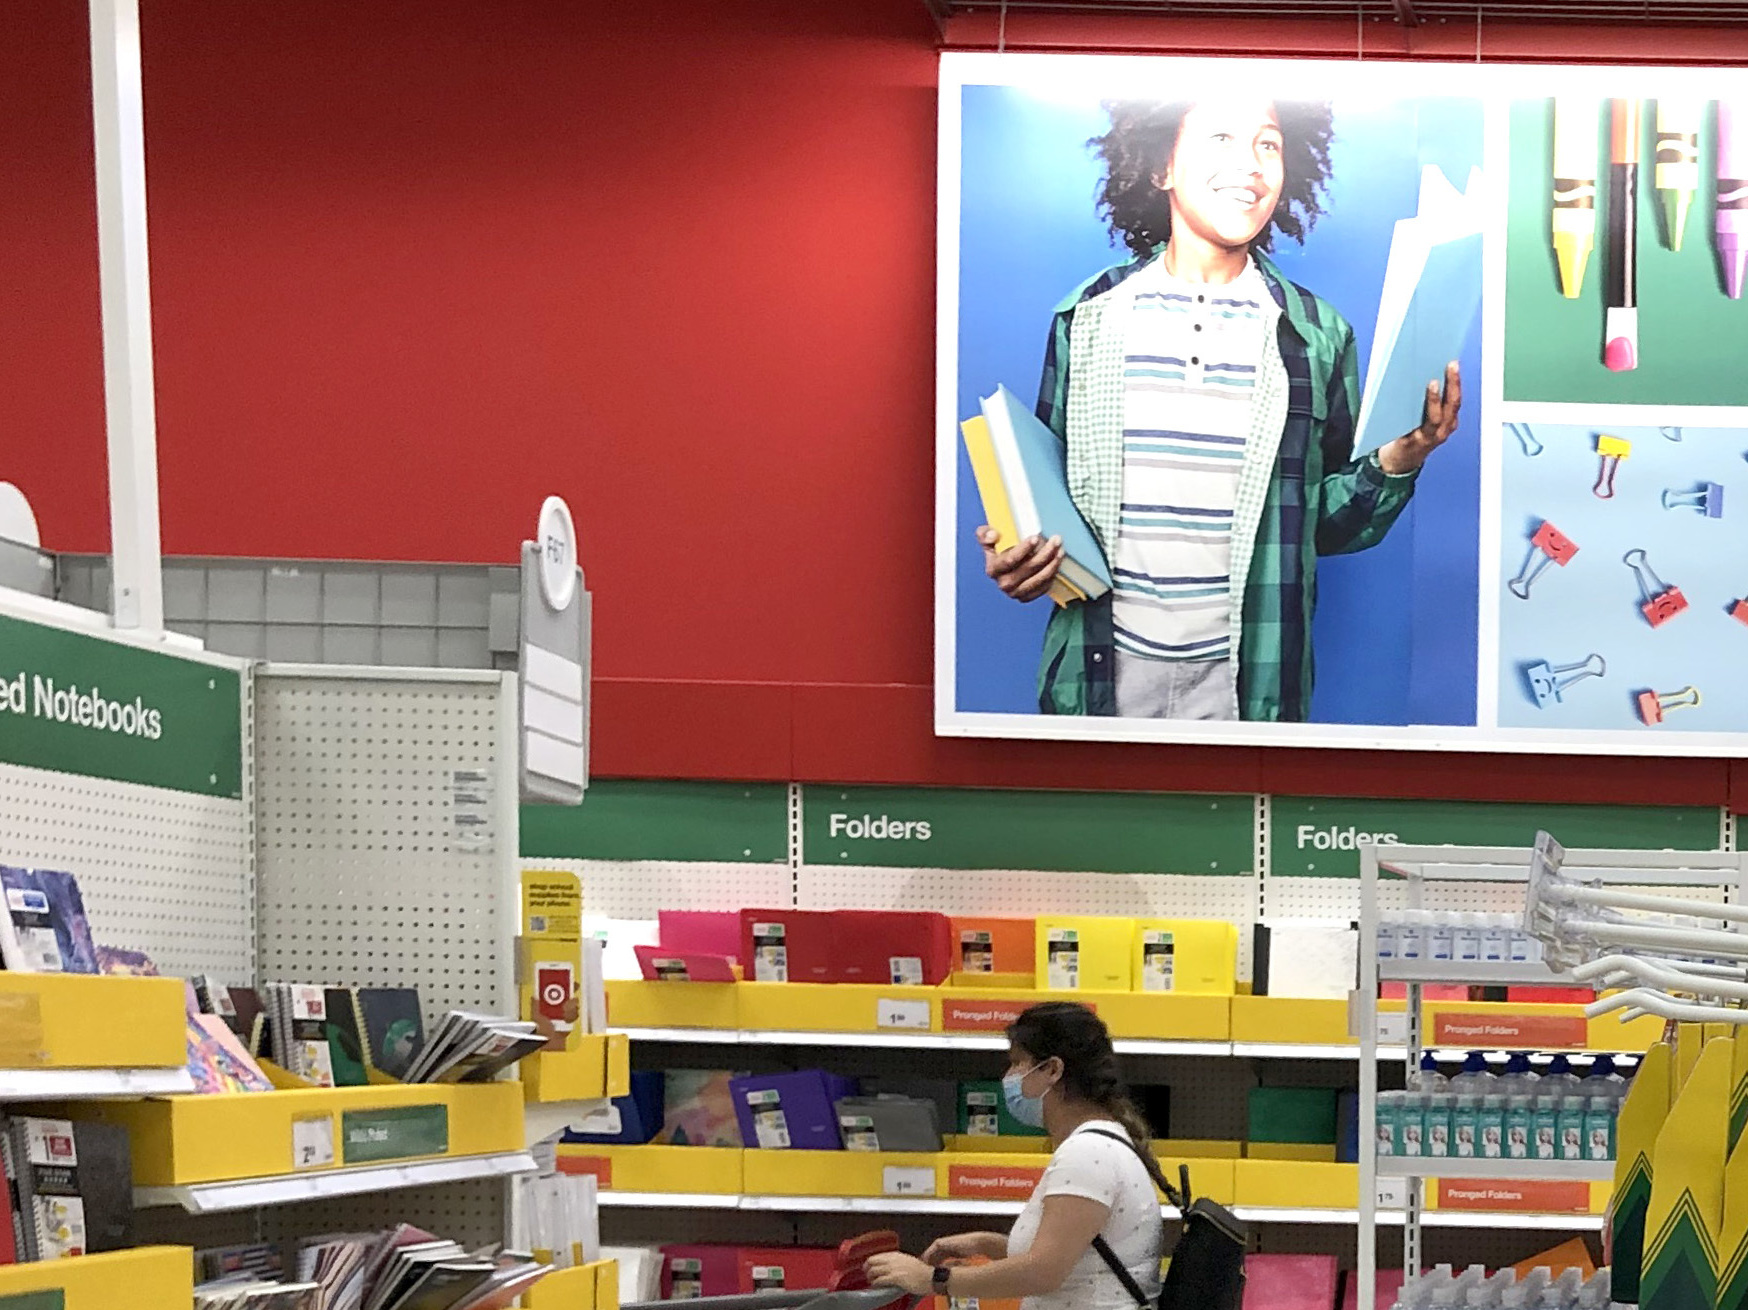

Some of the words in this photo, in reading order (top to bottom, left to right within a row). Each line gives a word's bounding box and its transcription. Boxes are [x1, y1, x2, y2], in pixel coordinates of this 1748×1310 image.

[0, 672, 26, 714] ed
[33, 674, 162, 740] Notebooks
[830, 814, 932, 842] Folders
[952, 1009, 993, 1021] Pronged
[1444, 1024, 1484, 1035] Pronged
[1485, 1025, 1519, 1035] Folders
[1448, 1189, 1487, 1200] Pronged
[1488, 1190, 1522, 1200] Folders
